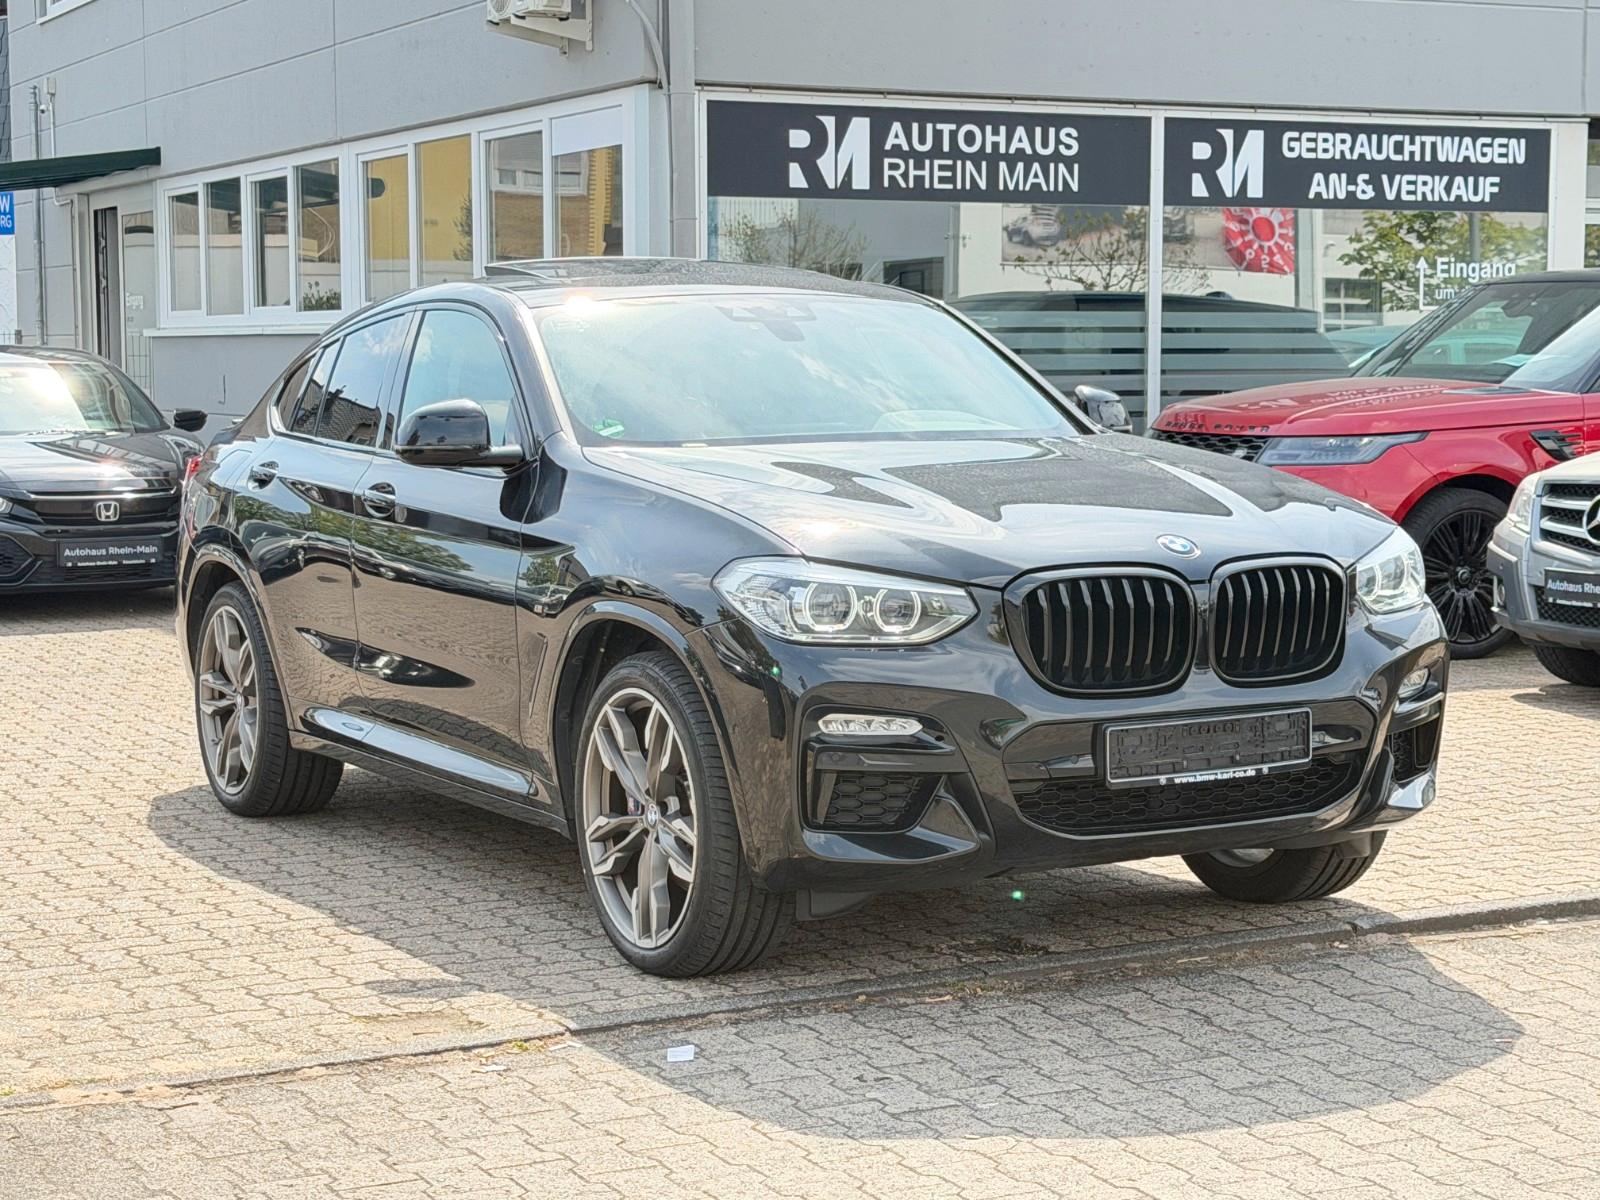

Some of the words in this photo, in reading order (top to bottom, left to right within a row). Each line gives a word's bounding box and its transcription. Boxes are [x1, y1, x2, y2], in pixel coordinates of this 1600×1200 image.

[788, 115, 870, 190] RM
[884, 121, 1080, 156] AUTOHAUS
[1281, 131, 1526, 165] GEBRAUCHTWAGEN
[883, 158, 987, 191] RHEIN
[998, 161, 1079, 193] MAIN
[1192, 128, 1265, 199] RM
[1381, 174, 1501, 204] VERKAUF
[1436, 255, 1516, 284] Eingang
[64, 548, 107, 557] Autohaus
[108, 545, 158, 555] Rhein-Main
[1546, 579, 1583, 593] Autohaus
